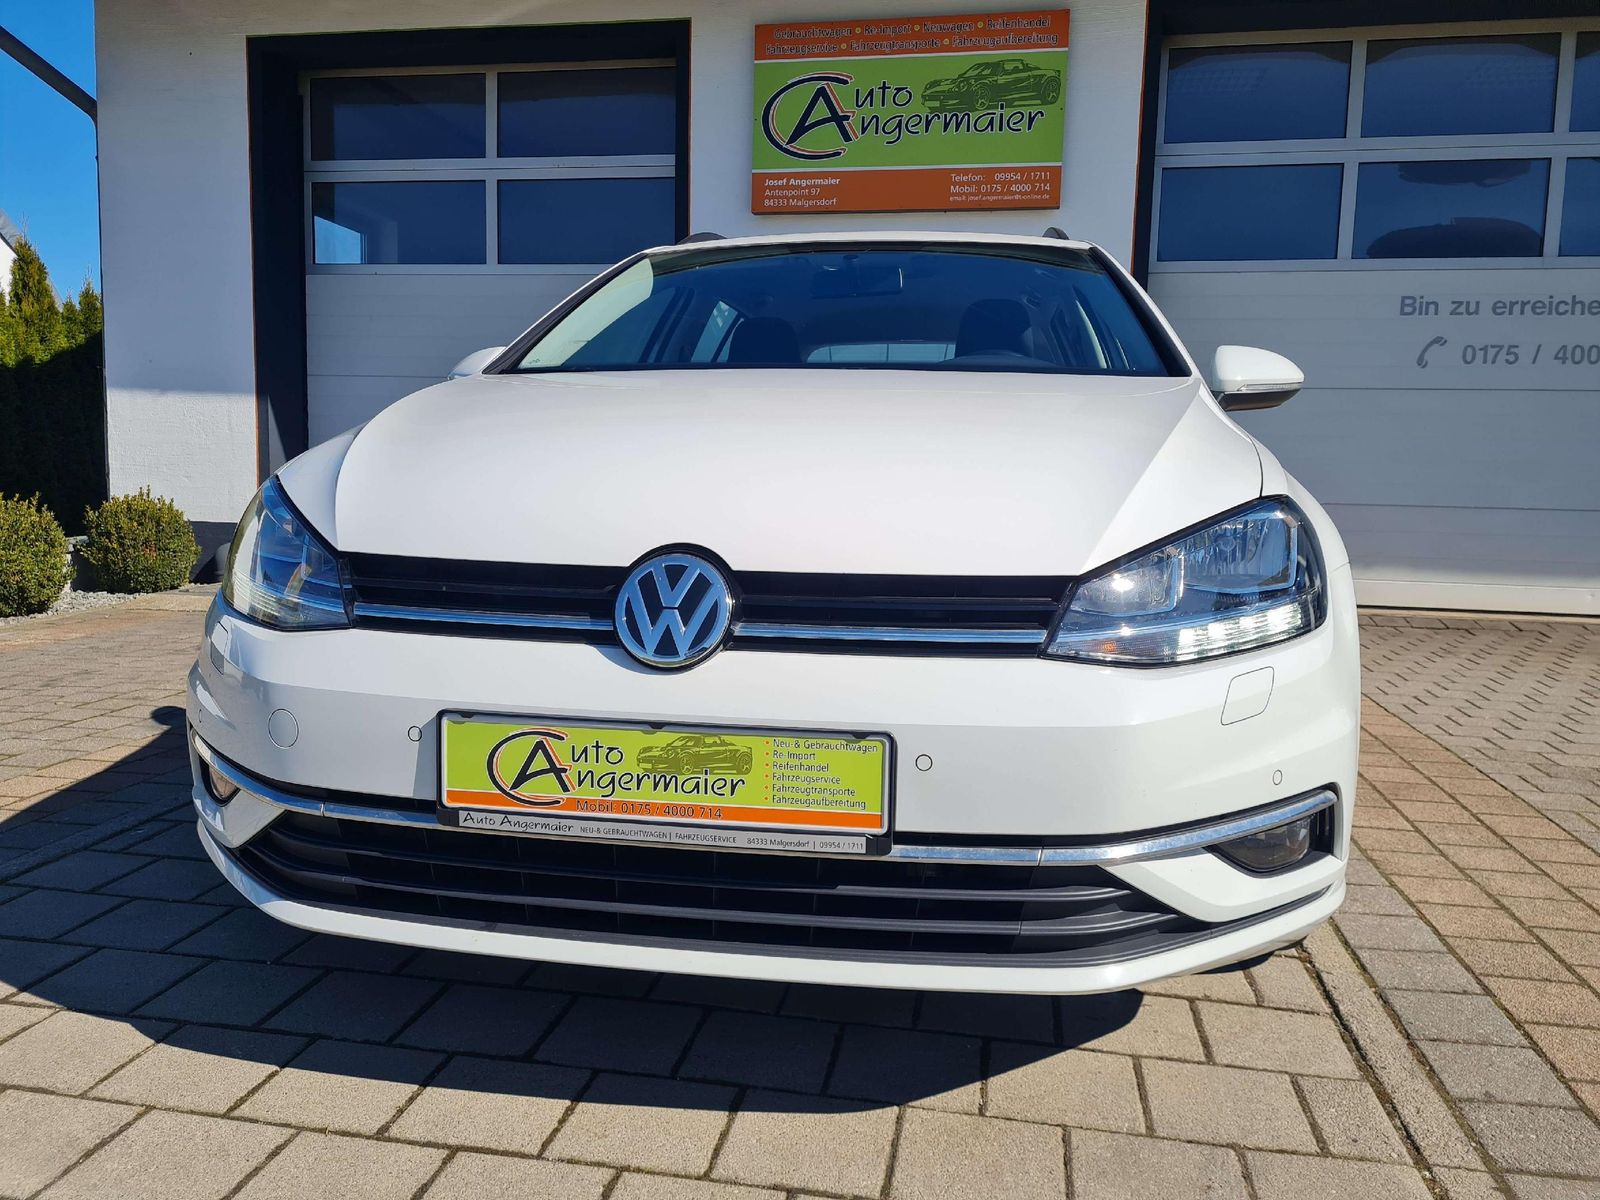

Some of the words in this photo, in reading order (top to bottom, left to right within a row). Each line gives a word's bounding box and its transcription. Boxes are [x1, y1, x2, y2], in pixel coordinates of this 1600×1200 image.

[774, 27, 852, 39] Gebrauchtwagen
[864, 24, 911, 36] Re-Import
[923, 21, 974, 33] Neuwagen
[986, 16, 1050, 29] Reifenhandel
[766, 43, 838, 55] Fahrzeugservice
[850, 38, 940, 53] Fahrzeugtransporte
[952, 33, 1058, 48] Fahrzeugaufbereitung
[764, 178, 788, 186] Josef
[789, 177, 841, 187] Angermaier
[950, 173, 986, 182] Telefon:
[994, 172, 1021, 181] 09954
[1030, 171, 1050, 180] 1711
[764, 188, 809, 197] Antenpoint
[810, 187, 820, 196] 97
[950, 185, 978, 193] Mobil:
[980, 184, 1002, 193] 0175
[1010, 183, 1032, 192] 4000
[1034, 183, 1050, 191] 714
[764, 198, 788, 207] 84333
[789, 197, 837, 208] Malgersdorf
[1399, 295, 1439, 316] Bin
[1448, 299, 1481, 316] zu
[1461, 343, 1520, 365] 0175
[1531, 343, 1543, 365] /
[615, 553, 732, 667] VW
[803, 740, 878, 754] Gebrauchtwagen
[773, 750, 816, 761] Re-Import
[772, 761, 829, 772] Reifenhandel
[772, 772, 841, 785] Fahrzeugservice
[772, 783, 856, 797] Fahrzeugtransporte
[576, 799, 616, 813] Mobil:
[621, 802, 651, 815] 0175
[663, 805, 695, 817] 4000
[700, 806, 722, 819] 714
[772, 795, 866, 810] Fahrzeugaufbereitung
[463, 811, 496, 826] Auto
[500, 815, 574, 832] Angermaier
[602, 827, 668, 840] GEBRAUCHTWAGEN
[675, 832, 737, 844] FAHRZEUGSERVICE
[746, 837, 768, 846] 84333
[769, 838, 811, 848] Malgersdorf
[819, 841, 841, 850] 09954
[847, 842, 864, 850] 1711
